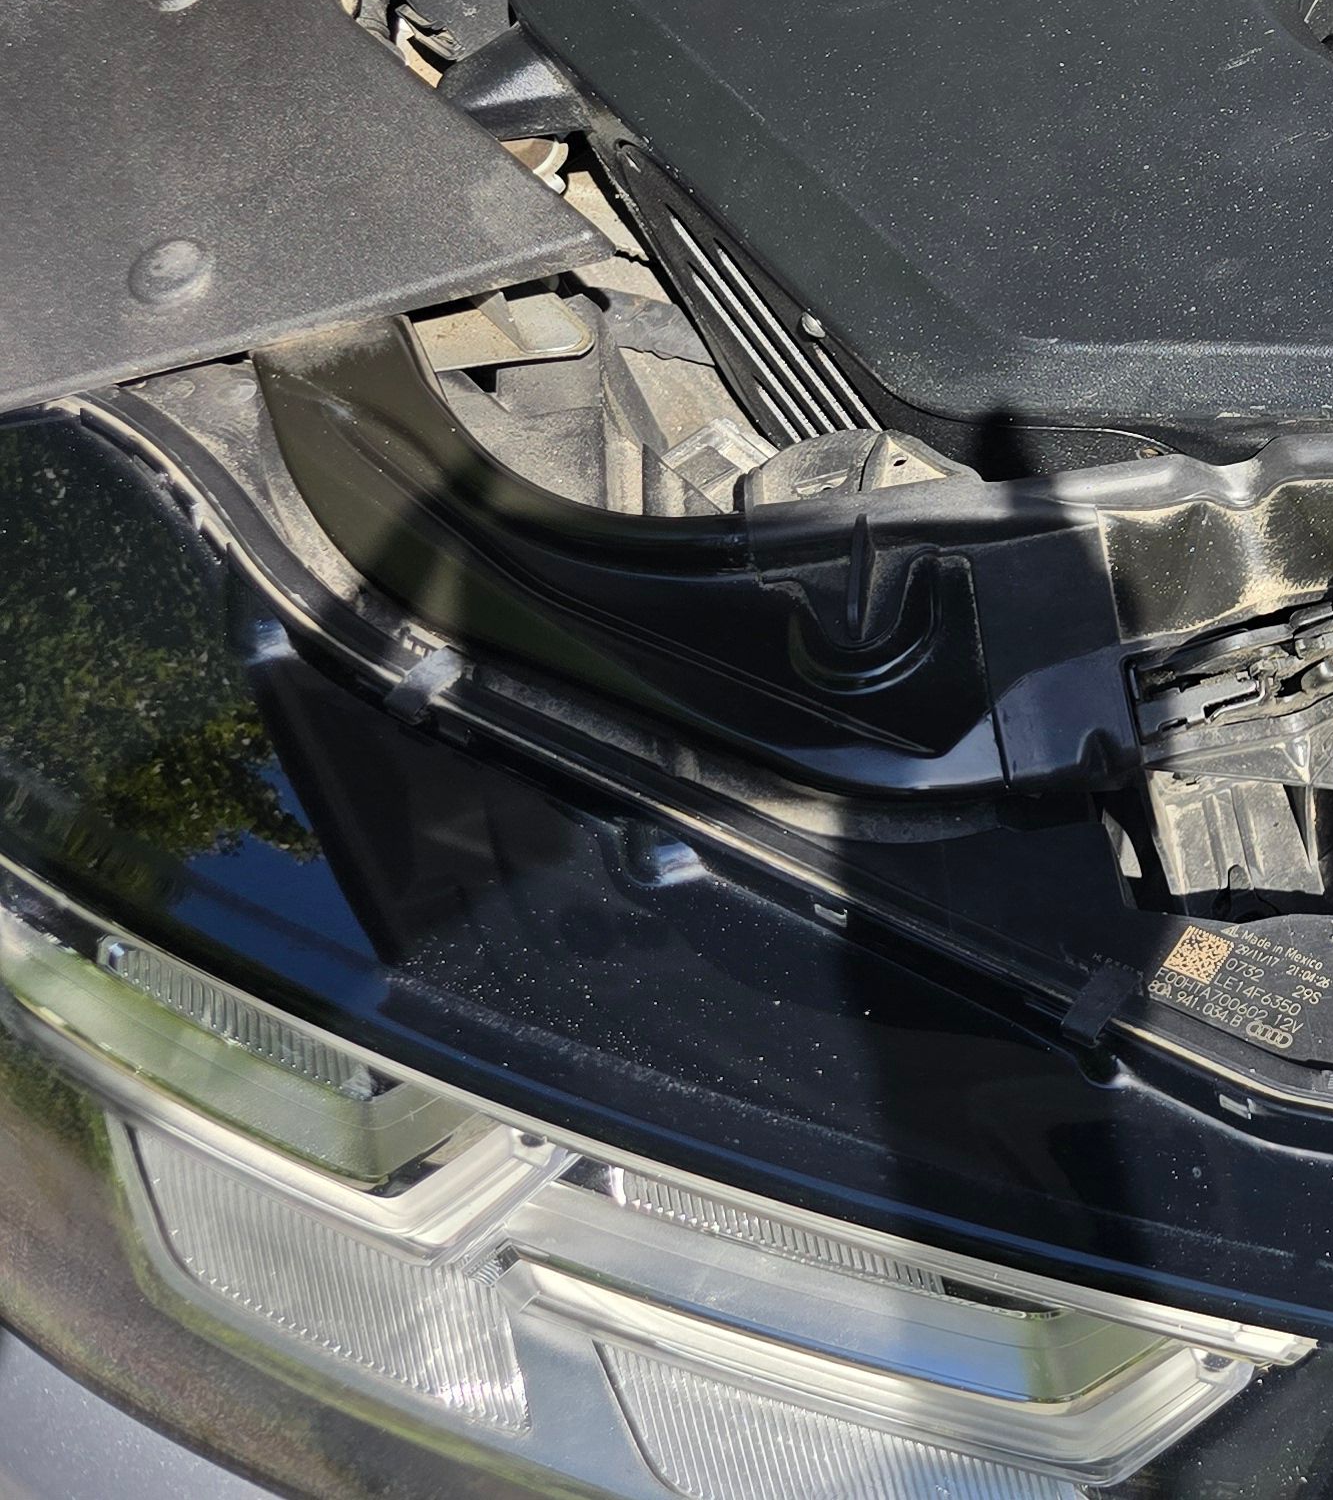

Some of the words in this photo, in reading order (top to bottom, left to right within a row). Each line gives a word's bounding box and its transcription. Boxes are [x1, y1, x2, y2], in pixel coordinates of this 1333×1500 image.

[1233, 943, 1280, 968] 29/11/17
[1284, 963, 1332, 989] 21:04:26
[1241, 931, 1272, 950] Made
[1285, 947, 1324, 971] Mexico
[1151, 966, 1271, 1023] F00HTA700602
[1271, 1013, 1304, 1035] 12V
[1211, 971, 1304, 1017] LE14F6350
[1223, 956, 1266, 982] 0732
[1291, 984, 1323, 1005] 29S
